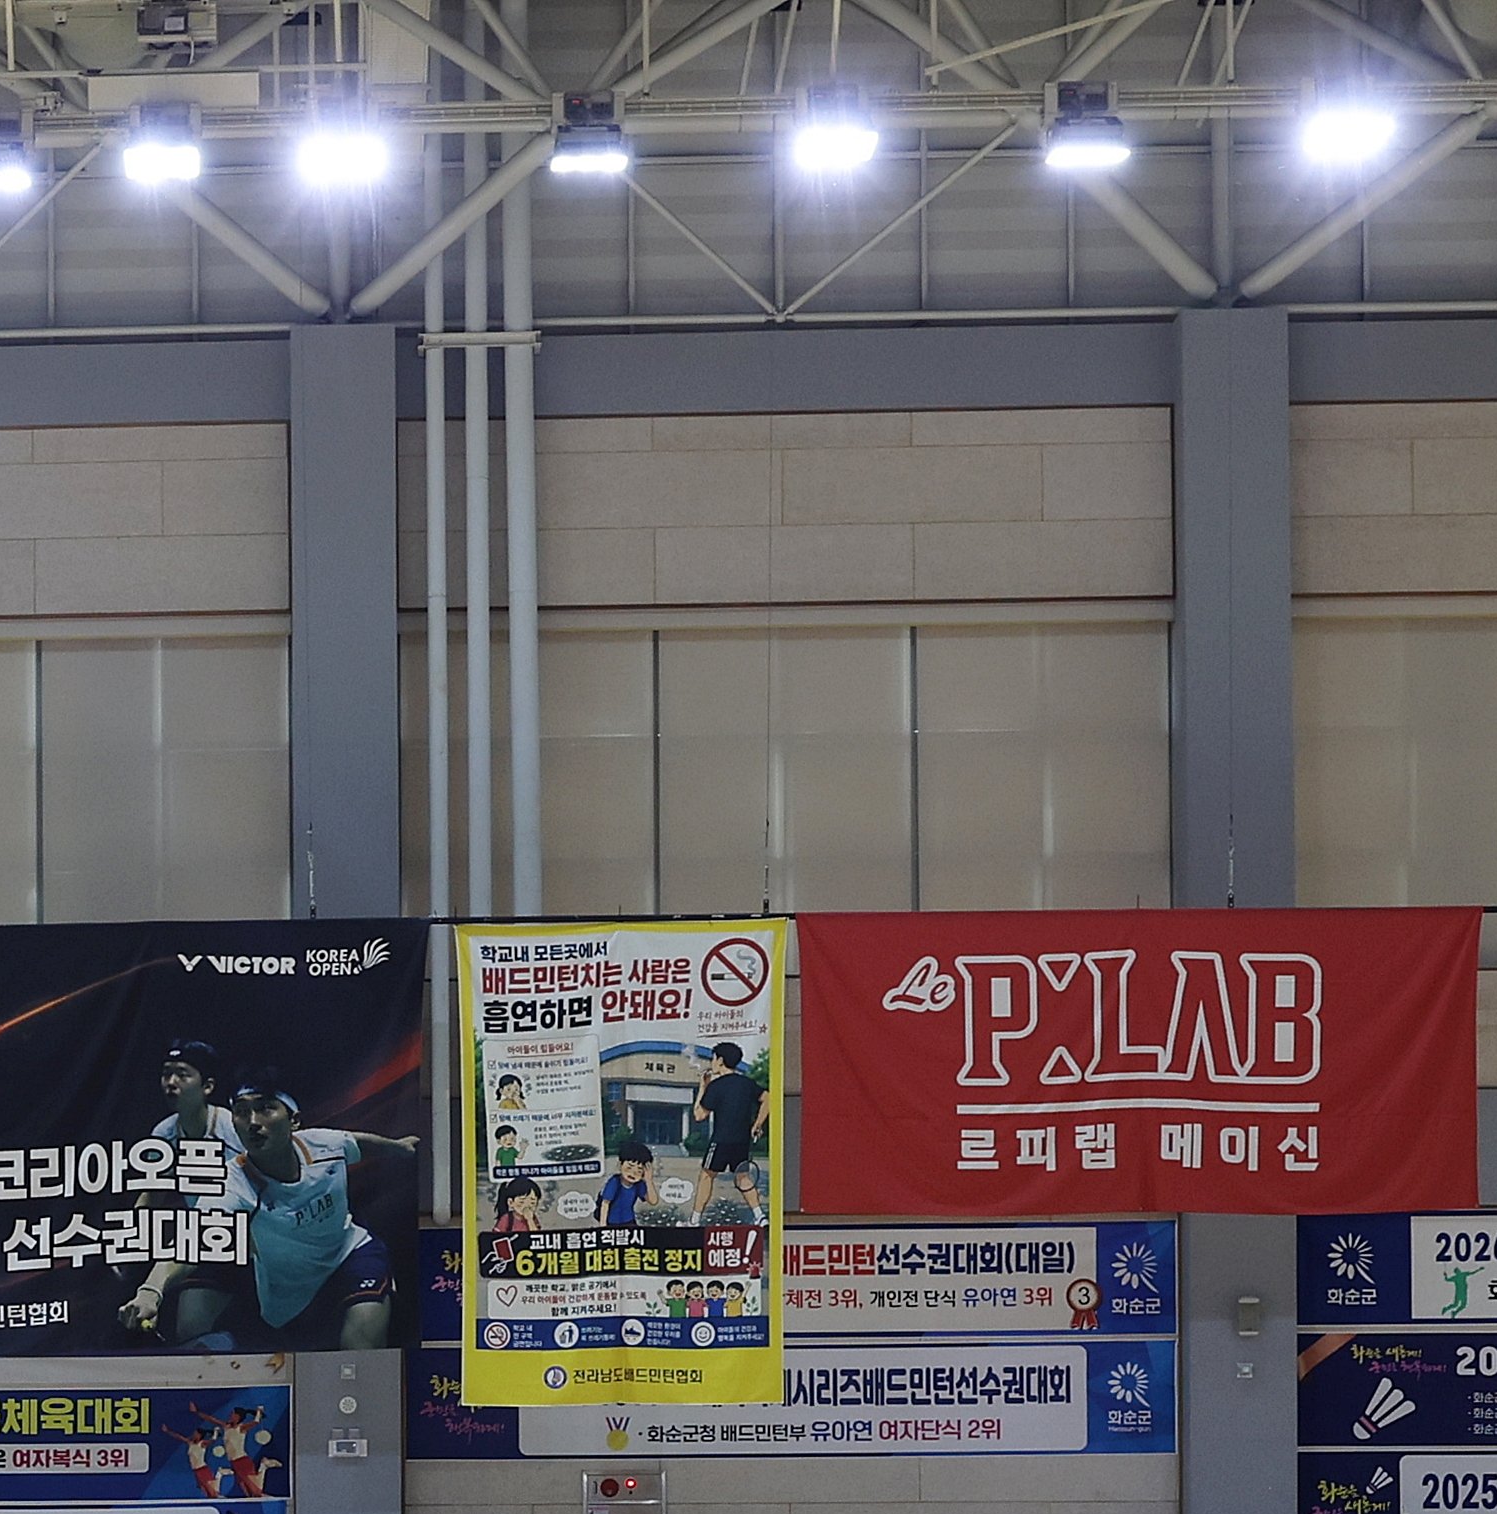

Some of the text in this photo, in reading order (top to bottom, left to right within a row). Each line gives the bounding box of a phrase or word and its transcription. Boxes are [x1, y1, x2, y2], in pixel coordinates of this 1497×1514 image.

[306, 949, 359, 963] KOREA
[480, 941, 607, 963] 학교내 모든곳에서
[207, 955, 296, 974] VICTOR
[309, 963, 352, 975] OPEN
[482, 958, 691, 995] 배드민턴치는 사람은
[483, 989, 692, 1034] 흡연하면 안돼요!
[956, 1123, 1321, 1172] 르피랩 메이신
[3, 1209, 249, 1270] 선수권대회
[530, 1229, 734, 1251] 교내 흡연 적발시 시행
[515, 1249, 701, 1275] 6개월 대회 출전 정지
[870, 1290, 919, 1308] 개인전
[923, 1289, 956, 1308] 단식
[962, 1288, 1017, 1307] 유아연
[1023, 1287, 1053, 1307] 3위
[1077, 1287, 1090, 1306] 3
[1327, 1288, 1377, 1306] 화순군
[573, 1368, 703, 1385] 전라남도배드민턴협회
[647, 1418, 1001, 1443] 화순군청 배드민턴부 유아연 여자단식 2위
[13, 1449, 92, 1468] 여자복식
[97, 1449, 129, 1468] 3위
